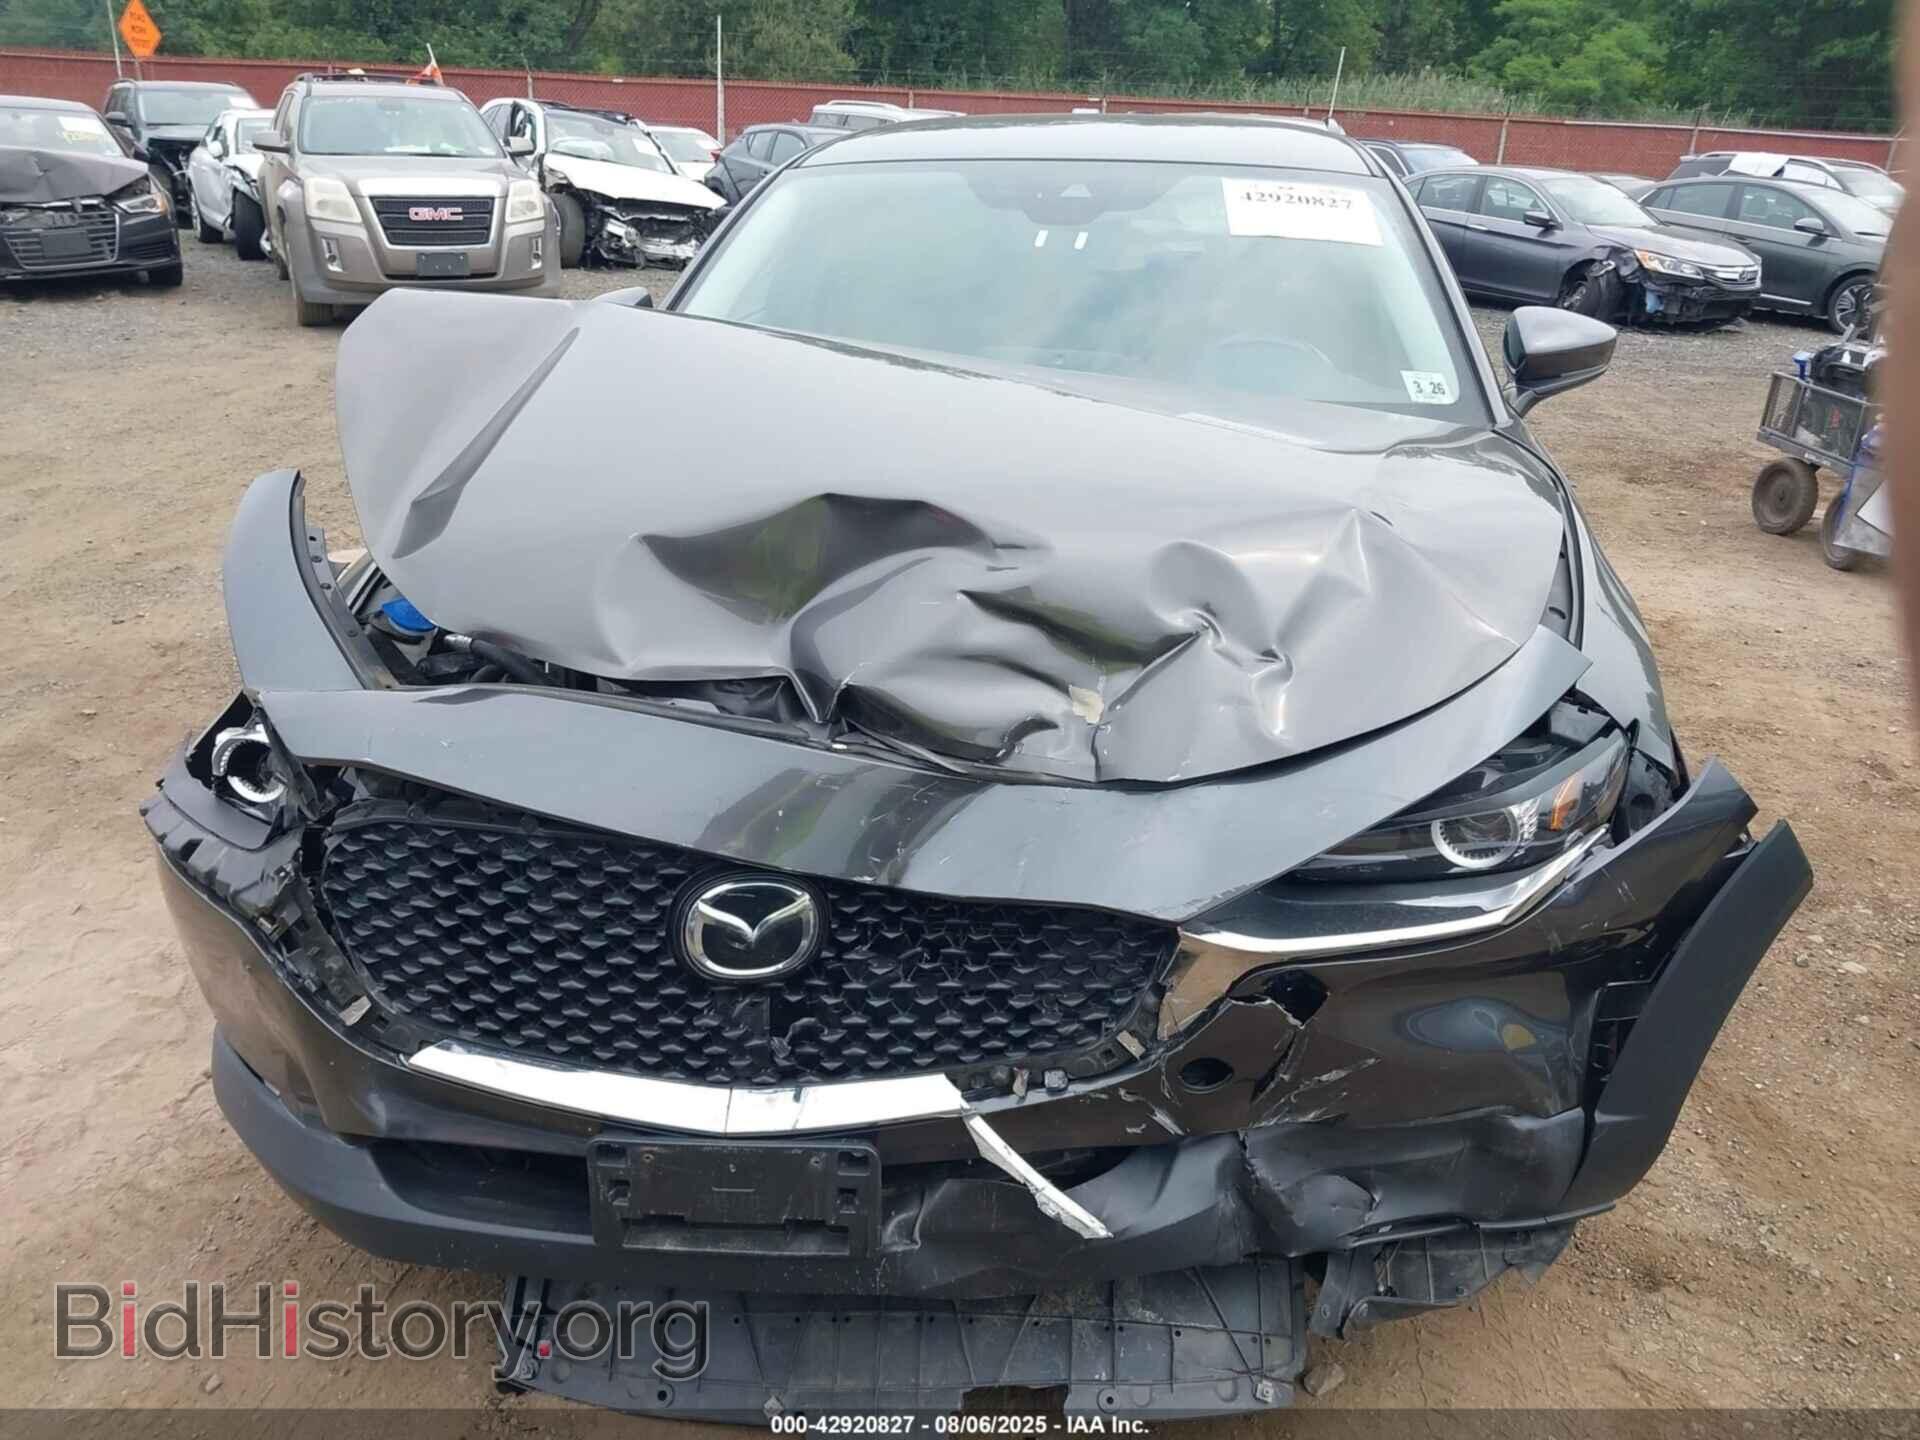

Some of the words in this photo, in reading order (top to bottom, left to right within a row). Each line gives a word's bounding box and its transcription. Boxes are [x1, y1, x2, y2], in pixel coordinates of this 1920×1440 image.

[408, 207, 464, 221] GMC
[1412, 380, 1424, 395] 3
[1429, 381, 1446, 395] 26
